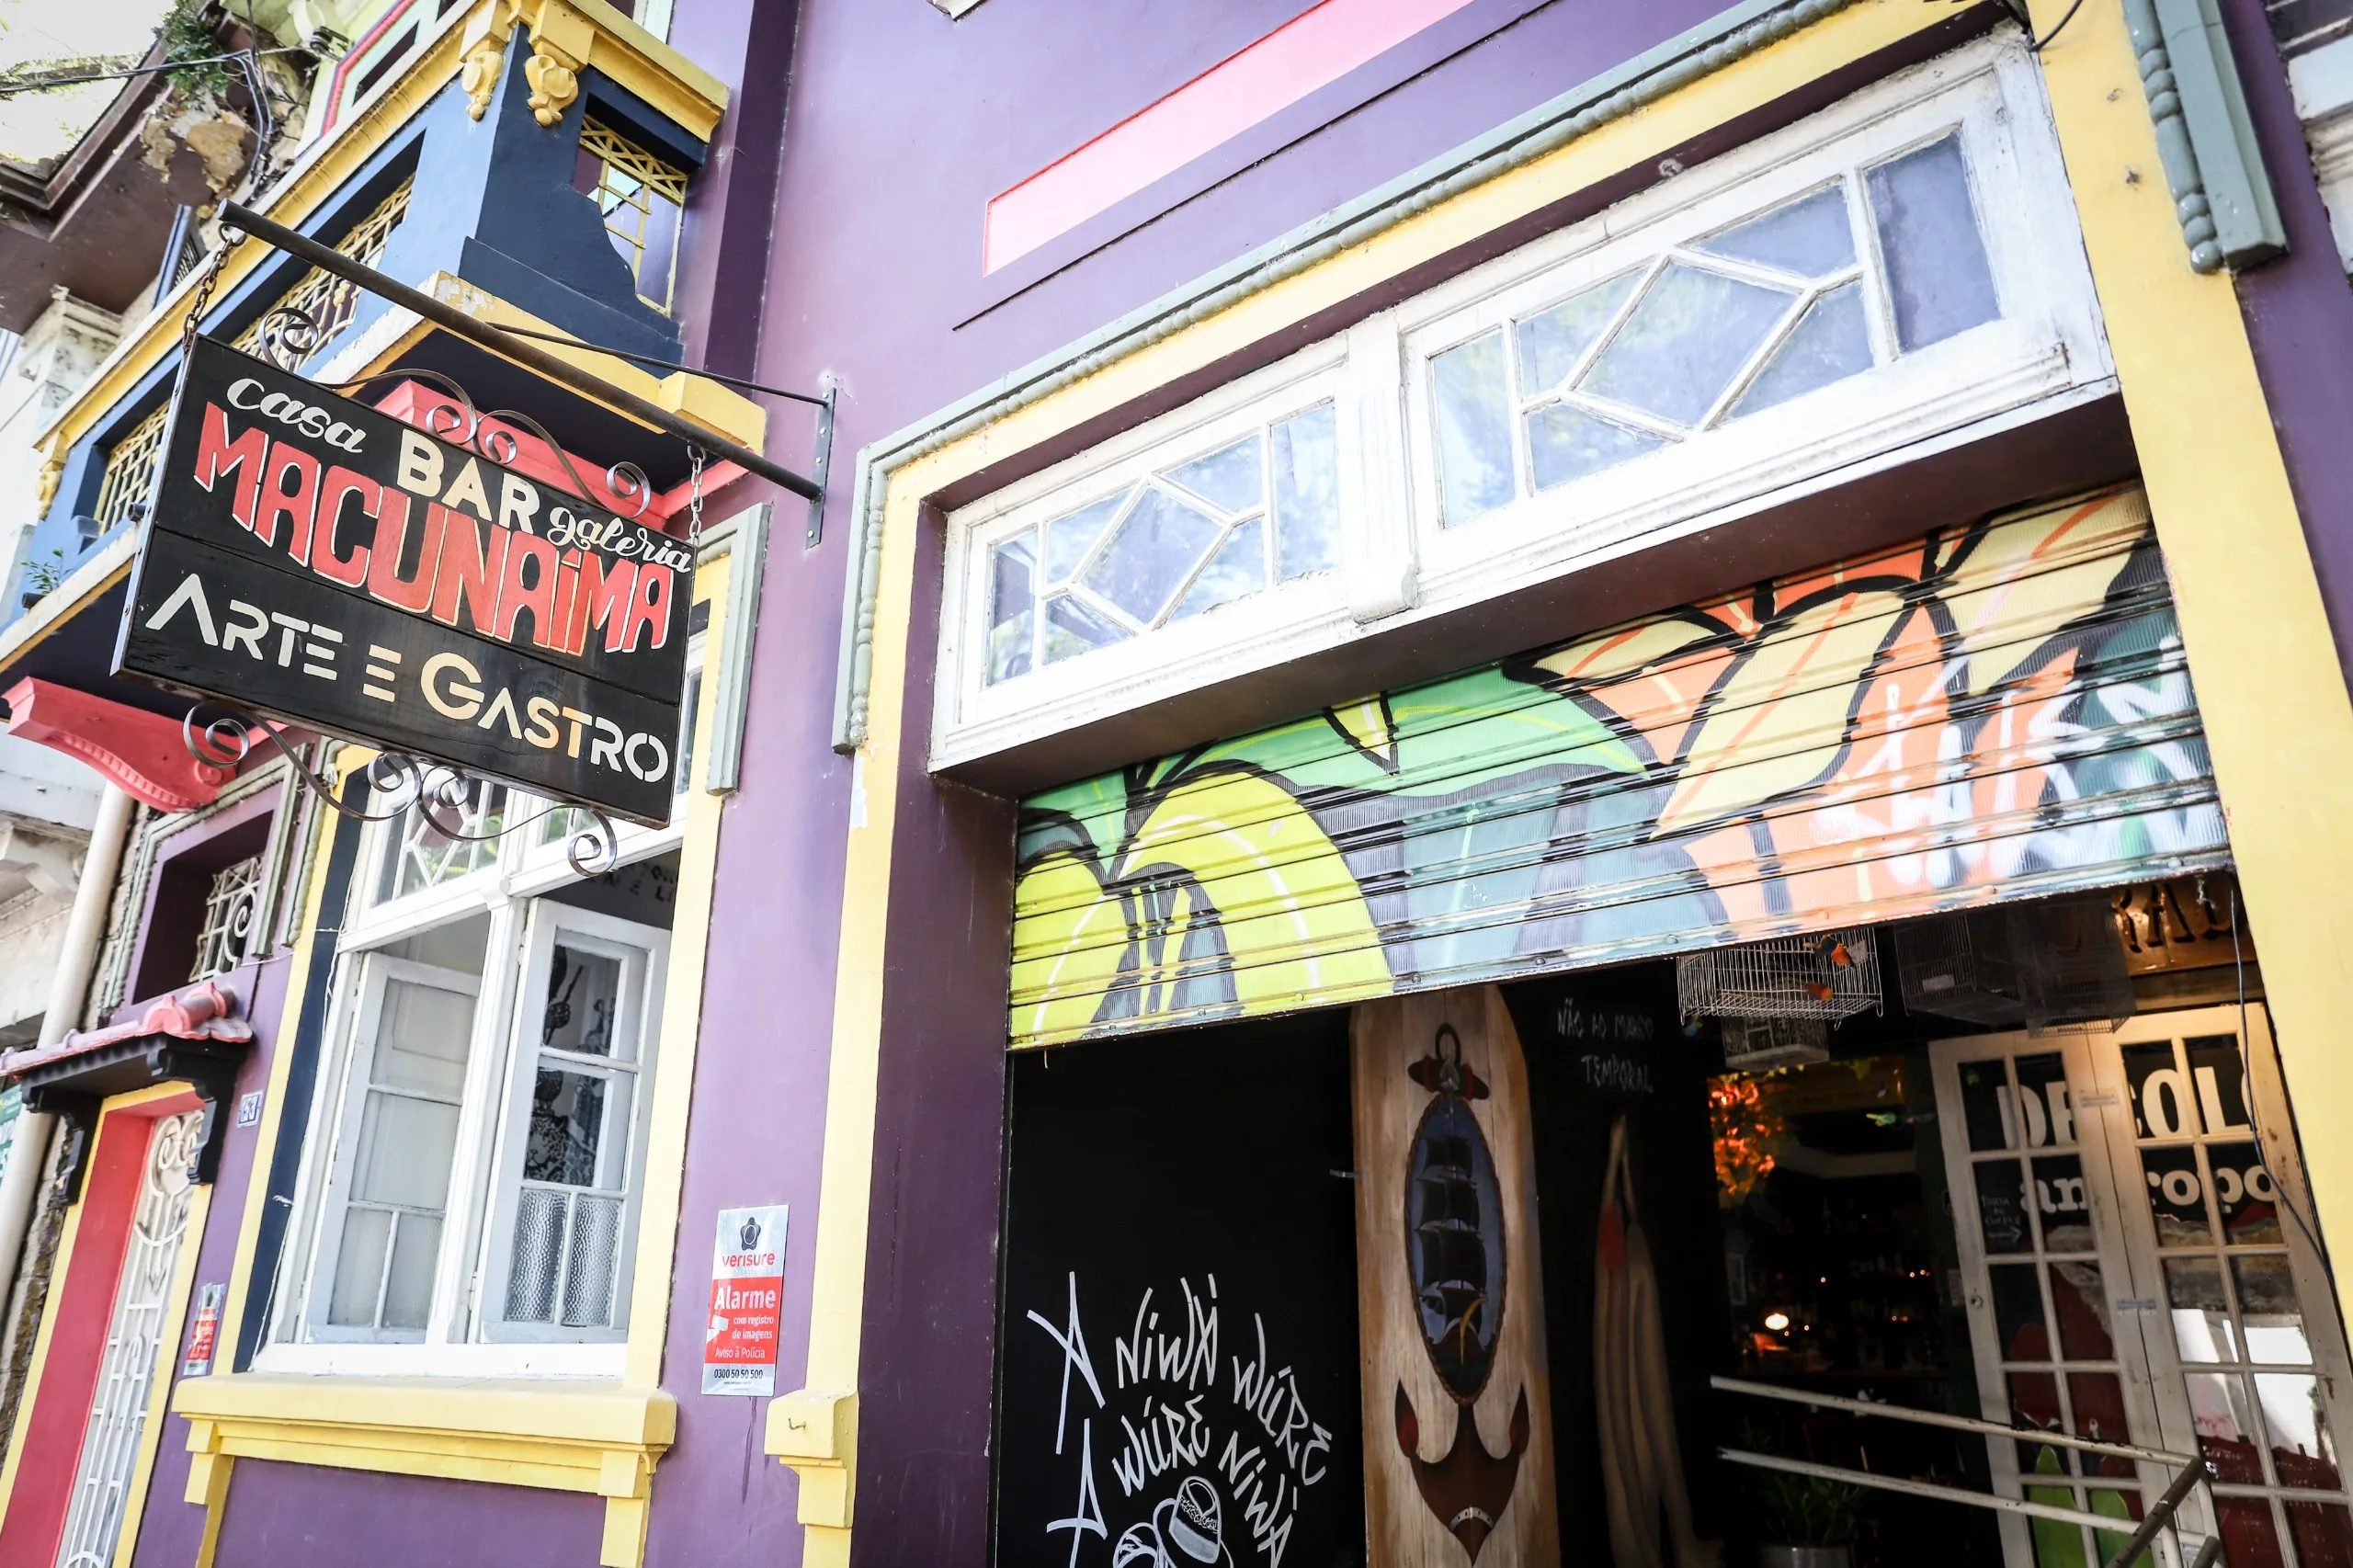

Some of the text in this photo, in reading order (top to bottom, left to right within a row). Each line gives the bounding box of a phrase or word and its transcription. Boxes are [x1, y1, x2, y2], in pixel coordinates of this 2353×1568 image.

[397, 428, 540, 535] BAR
[547, 506, 691, 573] galeria
[145, 573, 669, 782] ARTE E GASTRO
[1581, 1052, 1654, 1094] TEMPORAL
[722, 1252, 776, 1267] verisure
[714, 1285, 776, 1310] Alarme
[733, 1314, 775, 1326] com registro
[732, 1329, 773, 1341] de imagens
[715, 1346, 766, 1358] Aviso à Polícia
[714, 1369, 764, 1380] 0300 50 50 500
